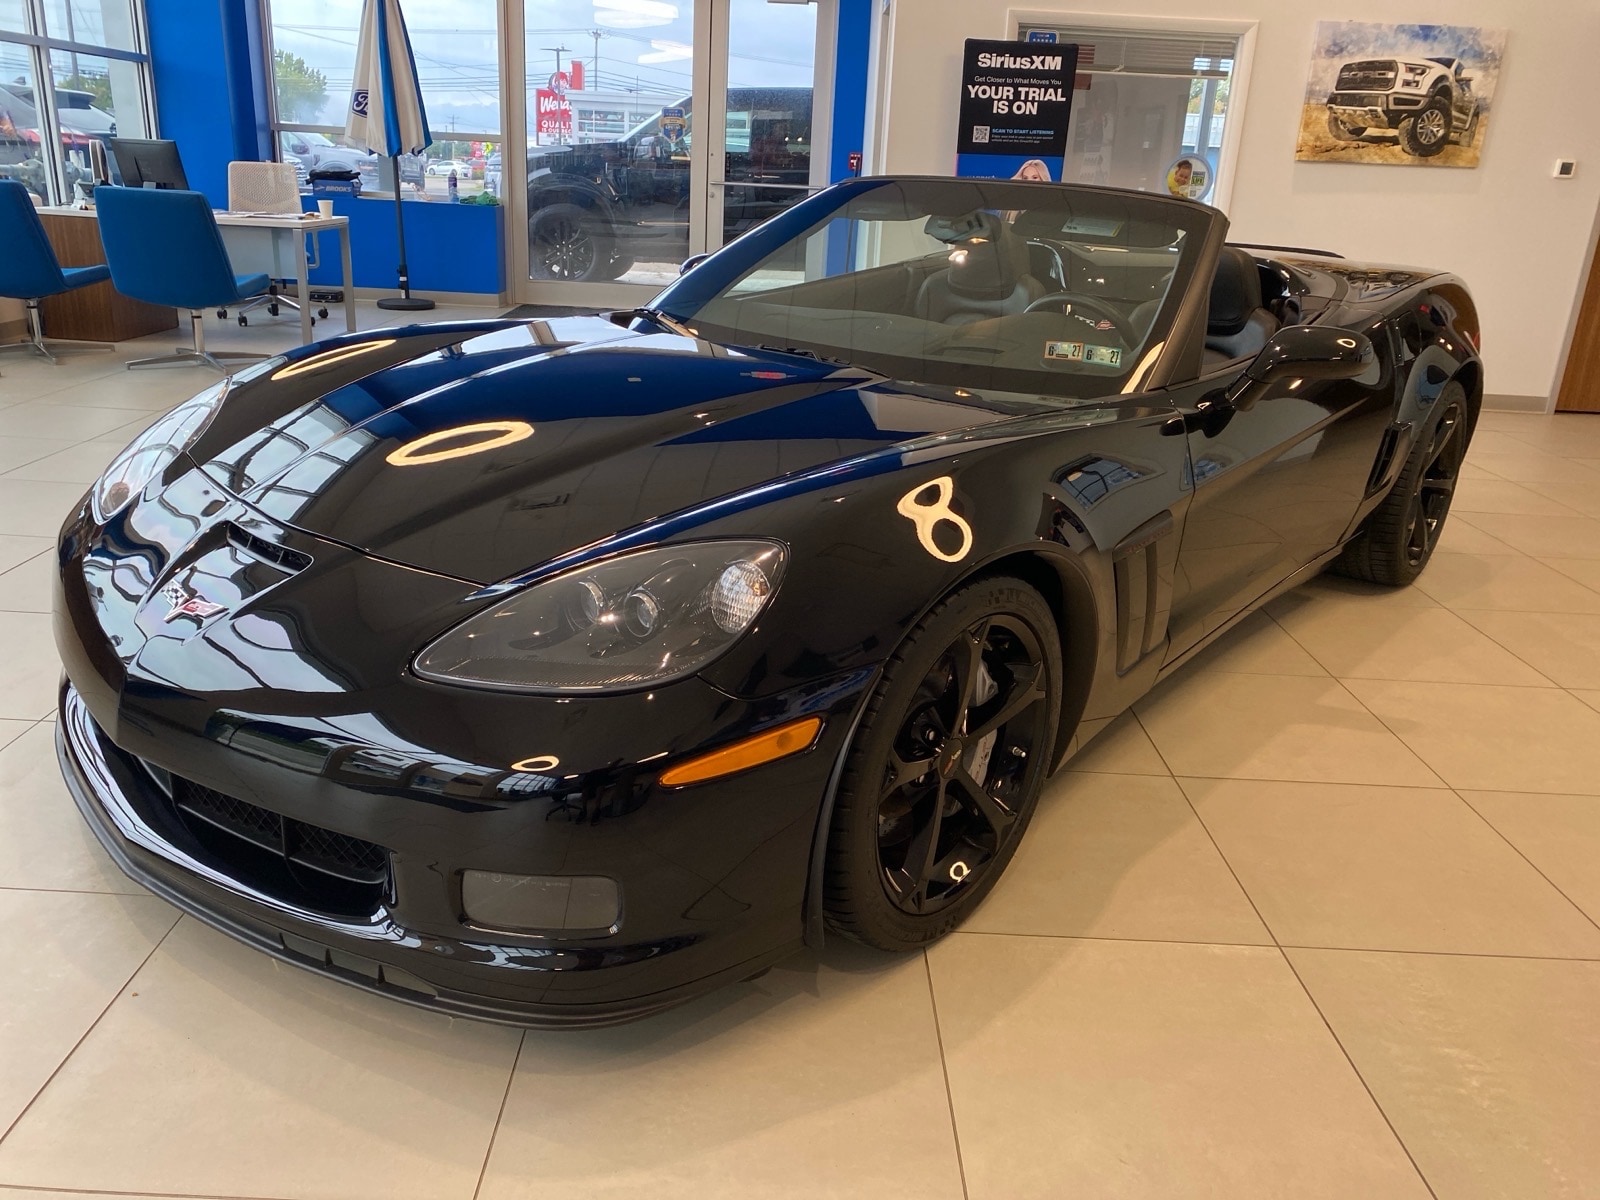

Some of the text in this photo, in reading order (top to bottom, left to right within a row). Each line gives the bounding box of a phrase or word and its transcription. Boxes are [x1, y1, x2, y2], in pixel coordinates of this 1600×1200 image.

[978, 53, 1062, 70] SiriusXM
[967, 84, 1066, 101] YOUR TRIAL
[992, 100, 1038, 115] IS ON
[325, 185, 352, 193] BROOKS
[1048, 344, 1081, 358] 6 27
[1086, 349, 1119, 364] 6 27
